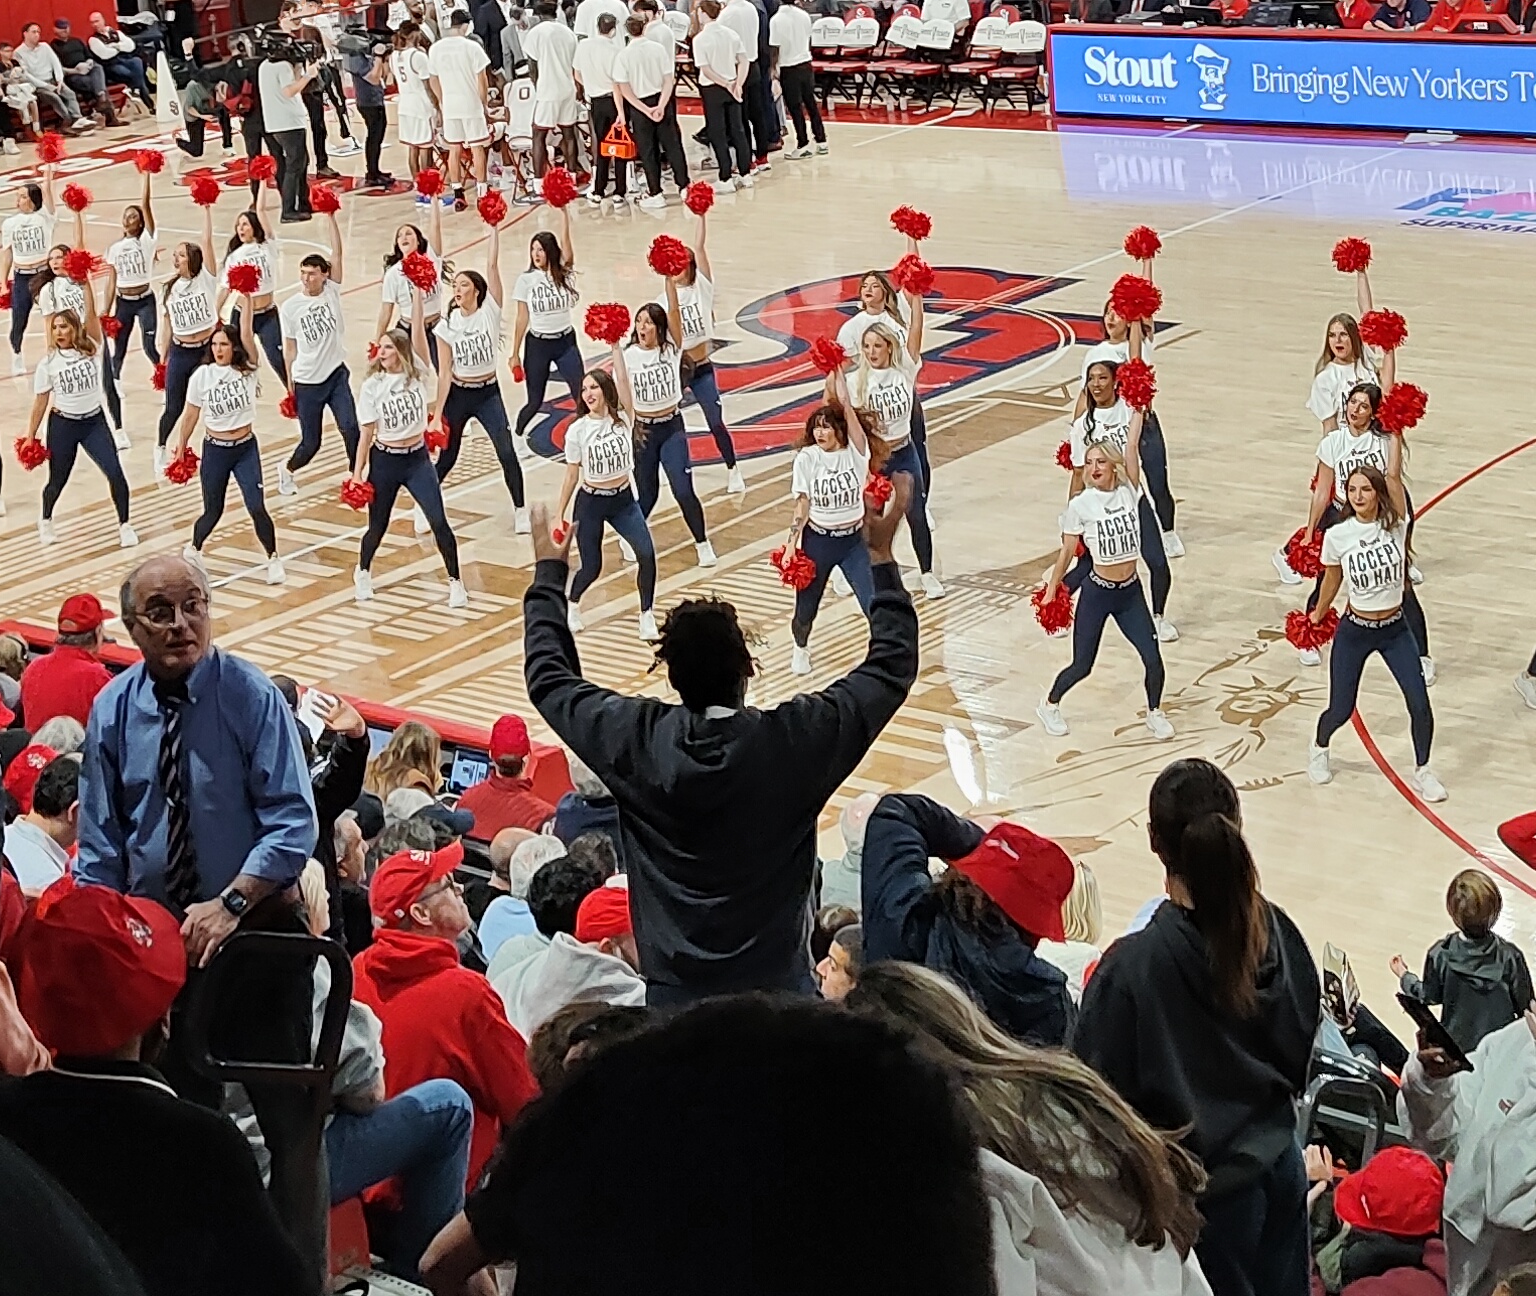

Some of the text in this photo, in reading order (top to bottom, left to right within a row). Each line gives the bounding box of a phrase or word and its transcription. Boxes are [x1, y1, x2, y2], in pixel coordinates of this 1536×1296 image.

[1083, 45, 1178, 90] Stout
[1251, 63, 1351, 104] Bringing
[1352, 66, 1408, 98] New
[1411, 68, 1508, 103] Yorkers
[1097, 93, 1167, 105] NEW YORK CITY
[633, 361, 675, 388] ACCEPT
[225, 392, 251, 413] HATE
[635, 378, 677, 403] NO HATE
[813, 467, 862, 495] ACCEPT
[814, 486, 861, 508] NO HATE
[1348, 538, 1403, 573] ACCEPT
[1350, 562, 1404, 588] NO HATE
